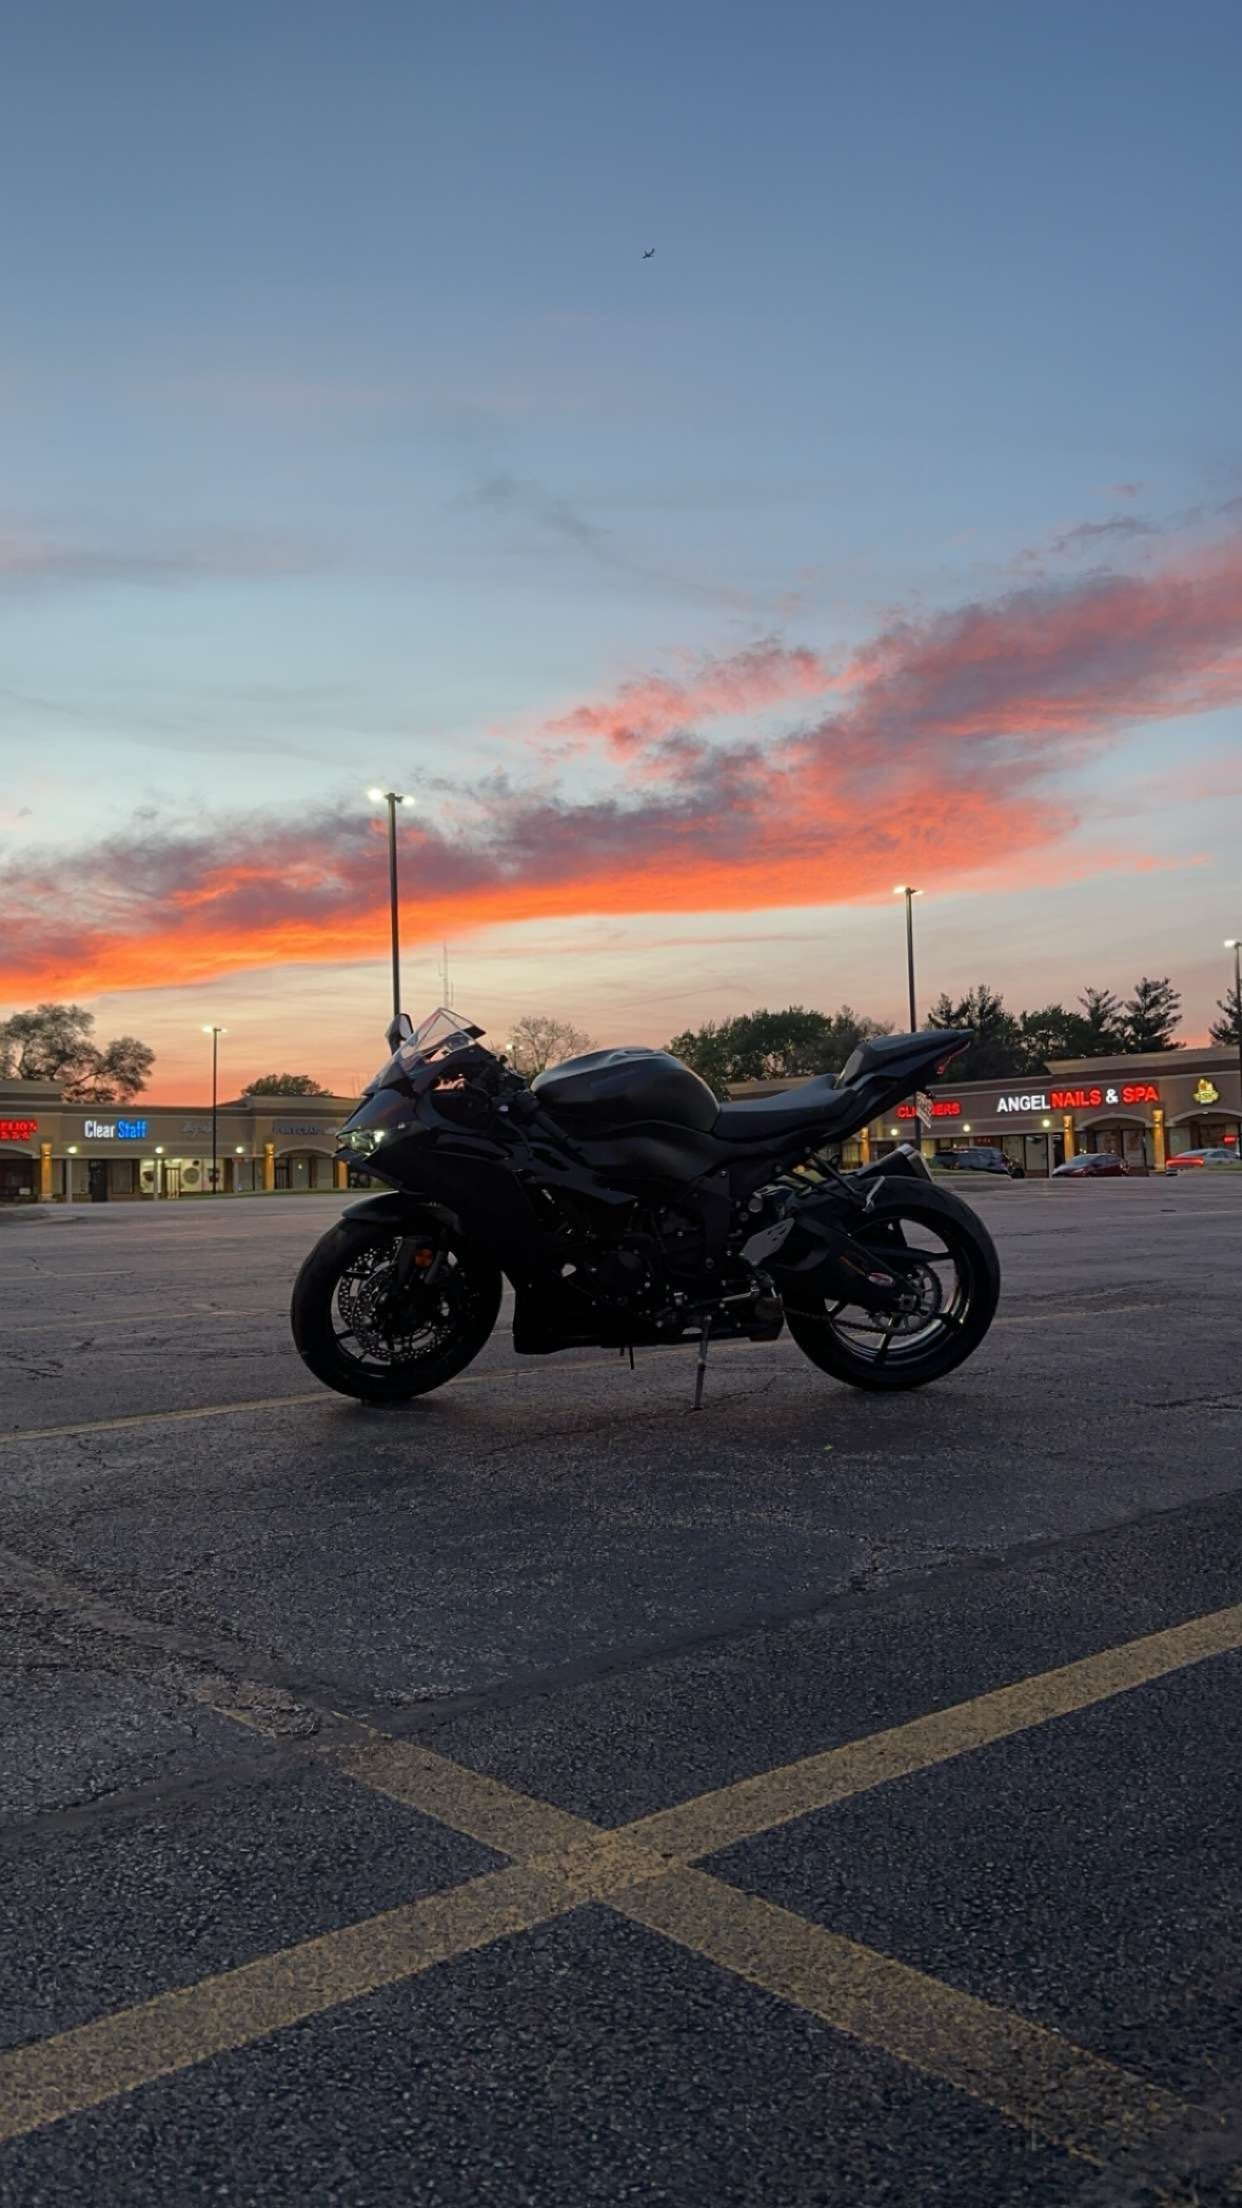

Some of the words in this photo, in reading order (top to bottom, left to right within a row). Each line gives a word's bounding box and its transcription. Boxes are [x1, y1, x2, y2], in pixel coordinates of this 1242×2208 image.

[996, 1095, 1051, 1112] ANGEL
[1051, 1090, 1102, 1108] NAILS
[1105, 1088, 1119, 1104] &
[1122, 1086, 1158, 1103] SPA
[896, 1102, 961, 1118] CLERS
[84, 1120, 116, 1138] Clear
[117, 1120, 147, 1138] Staff
